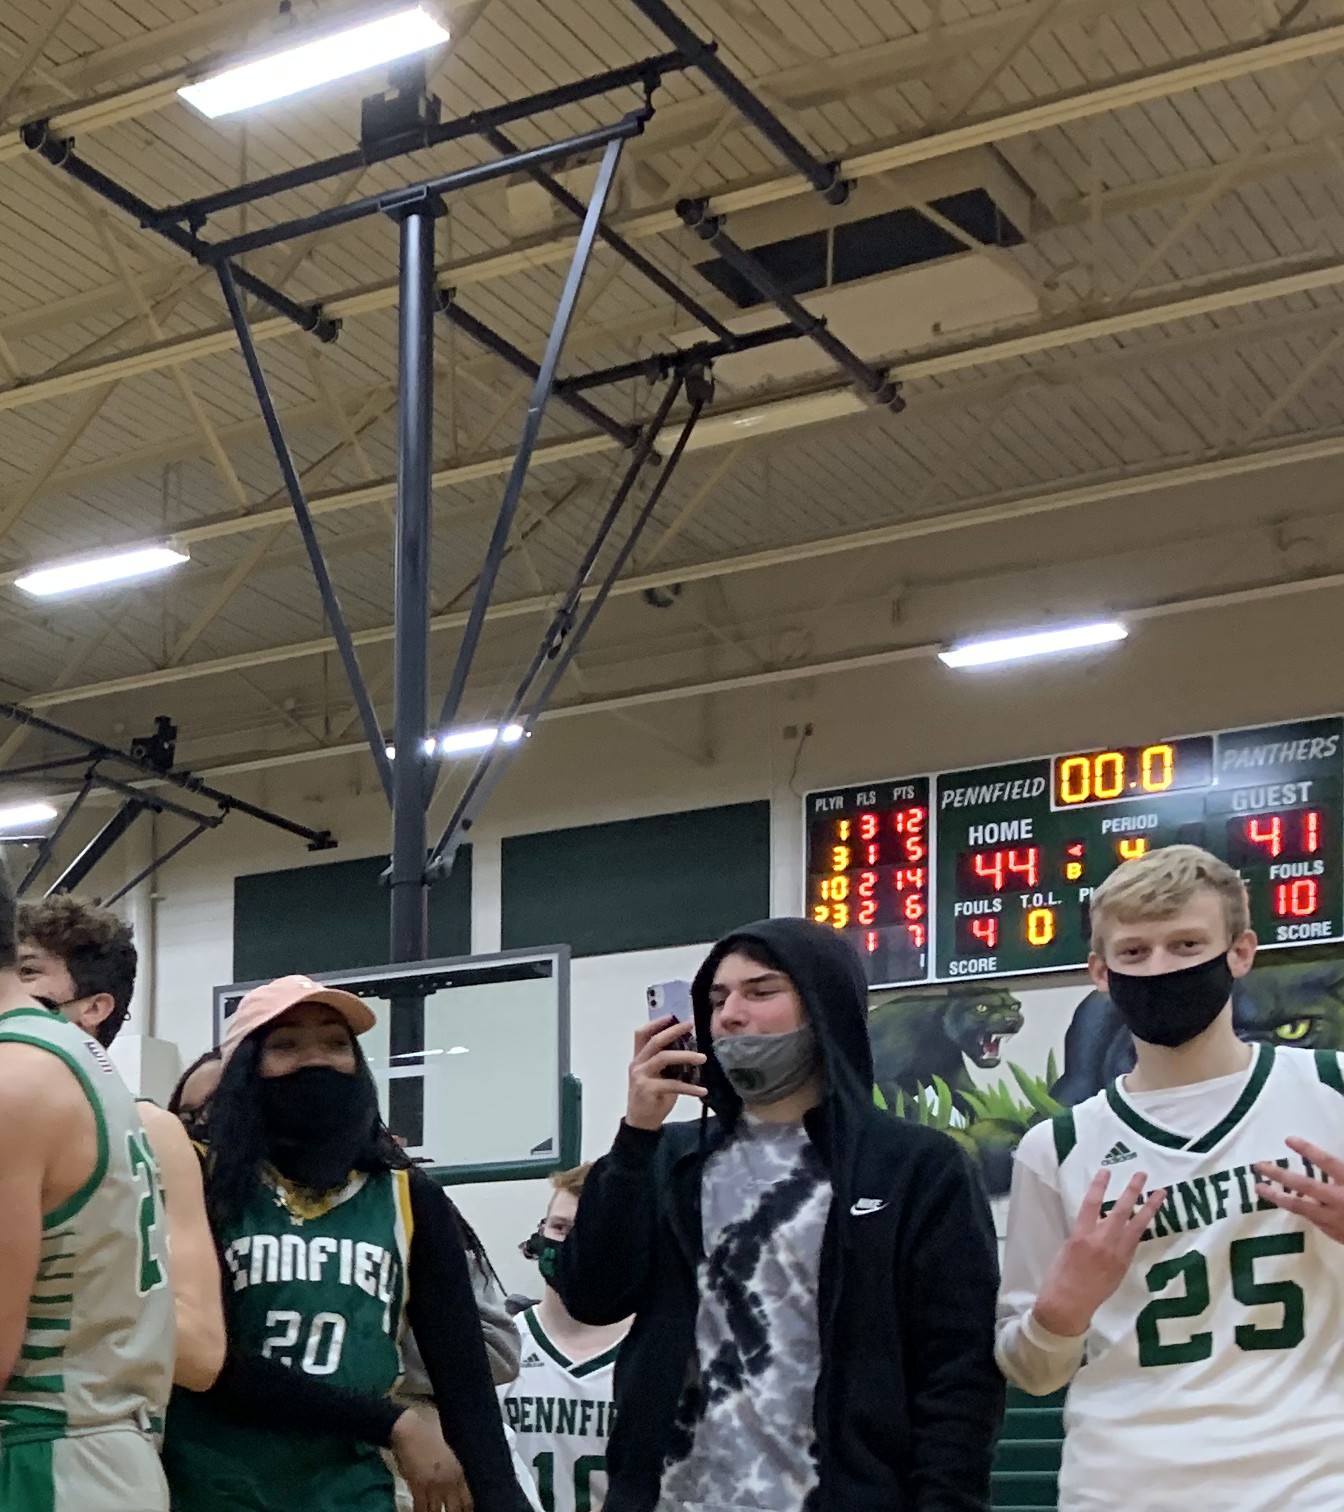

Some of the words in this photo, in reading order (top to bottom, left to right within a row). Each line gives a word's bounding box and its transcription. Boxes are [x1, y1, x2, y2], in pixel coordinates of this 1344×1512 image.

[1221, 734, 1341, 771] PANTHERS
[815, 796, 844, 812] PLYR
[856, 791, 877, 806] FLS
[893, 785, 915, 800] PTS
[941, 776, 1046, 810] PENNFIELD
[1231, 780, 1313, 811] GUEST
[861, 814, 877, 839] 3
[896, 808, 924, 833] 12
[968, 818, 1034, 846] HOME
[1101, 813, 1159, 835] PERIOD
[1248, 811, 1321, 858] 41
[832, 845, 850, 872] 3
[905, 835, 924, 862] 5
[974, 847, 1039, 891] 44
[1269, 859, 1325, 880] FOULS
[820, 875, 850, 901] 10
[858, 871, 877, 897] 2
[896, 867, 924, 891] 14
[1275, 878, 1319, 916] 10
[858, 900, 877, 925] 2
[904, 894, 924, 920] 6
[954, 898, 1002, 917] FOULS
[1020, 891, 1062, 909] T.O.L.
[907, 923, 925, 948] 7
[971, 917, 997, 949] 4
[1026, 907, 1056, 946] 0
[1276, 920, 1333, 942] SCORE
[948, 957, 998, 976] SCORE
[1136, 1231, 1306, 1368] 25
[261, 1310, 346, 1375] 20
[504, 1396, 619, 1438] PENNFI
